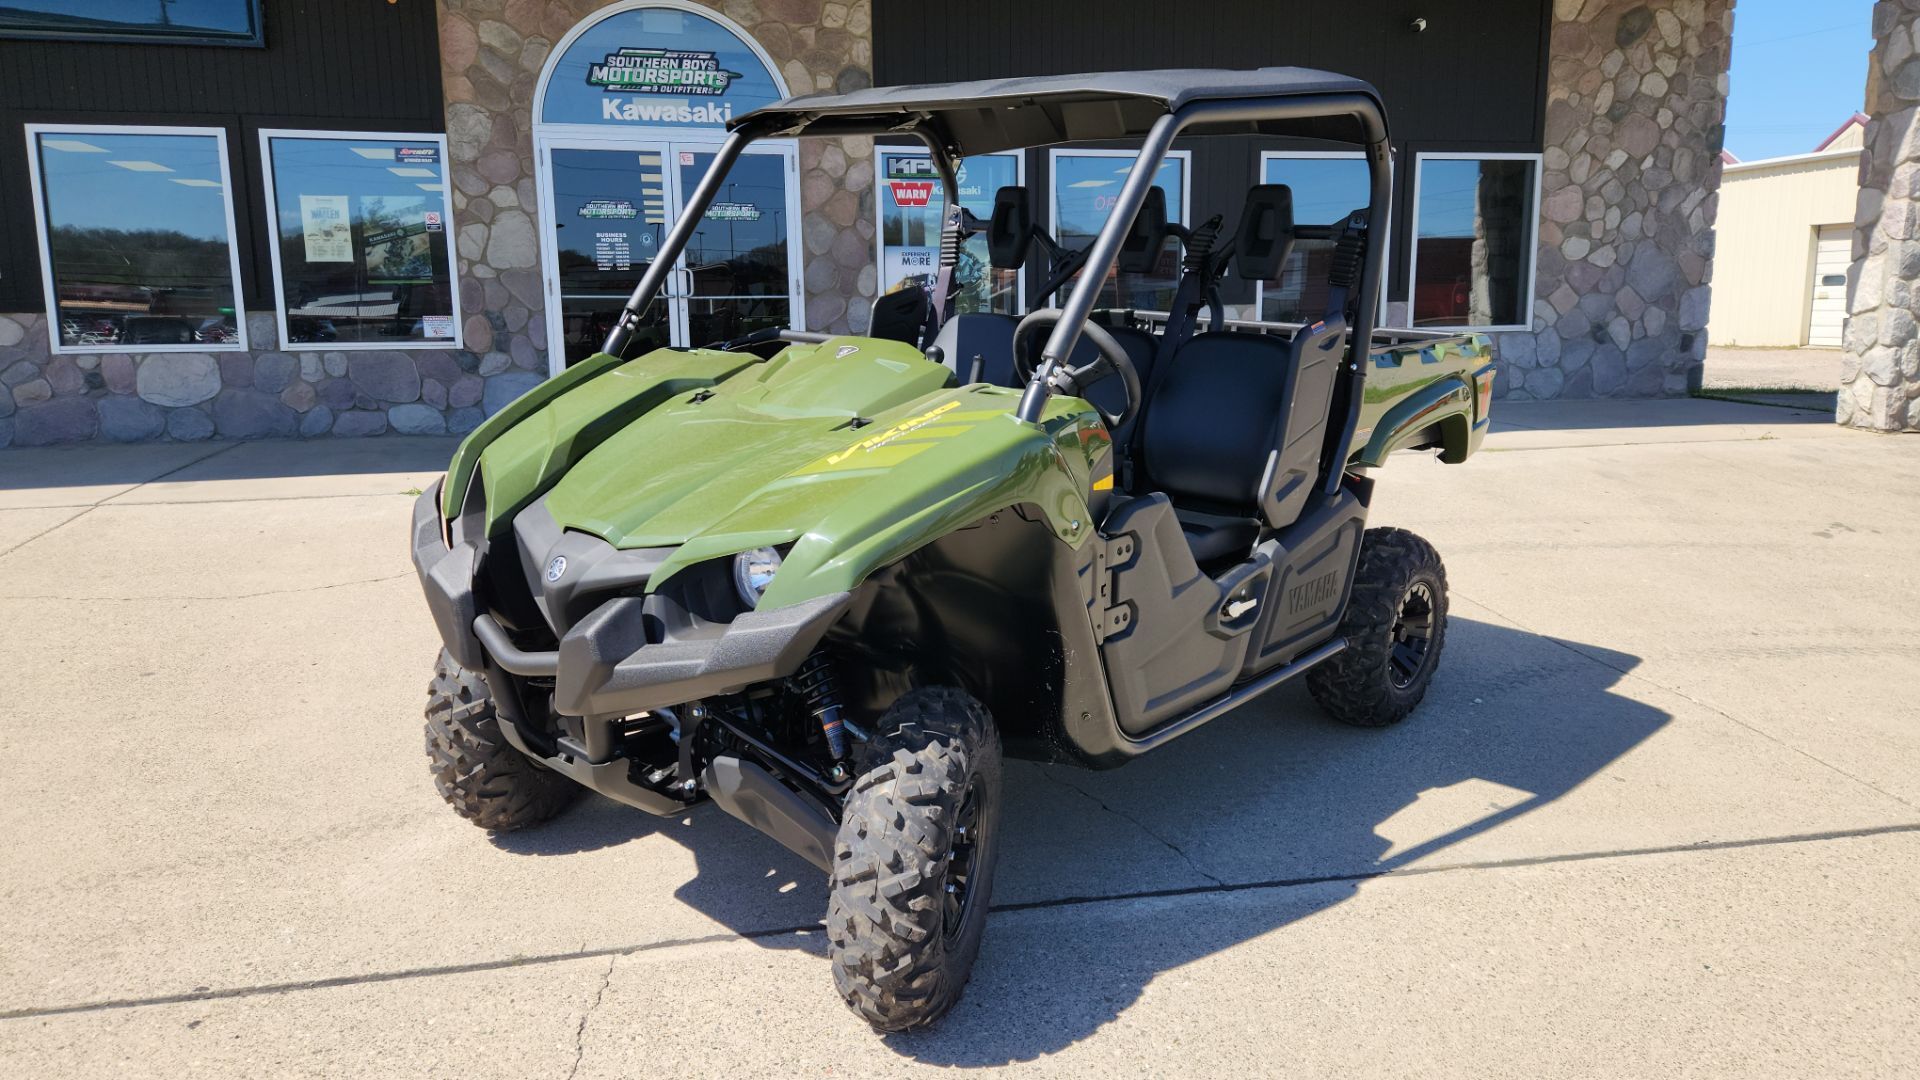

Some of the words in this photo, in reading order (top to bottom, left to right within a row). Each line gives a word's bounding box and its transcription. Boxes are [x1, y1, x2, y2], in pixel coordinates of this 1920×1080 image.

[607, 56, 679, 69] SOUTHERN
[682, 59, 717, 71] BOYS
[592, 66, 728, 86] MOTORSPORTS
[660, 86, 714, 94] OUTFITTERS
[602, 98, 732, 123] Kawasaki
[896, 189, 927, 199] WARN
[932, 186, 981, 195] Kasaki
[901, 257, 931, 266] MORE
[826, 400, 961, 465] VIKING
[1289, 569, 1339, 615] YAMAHA
